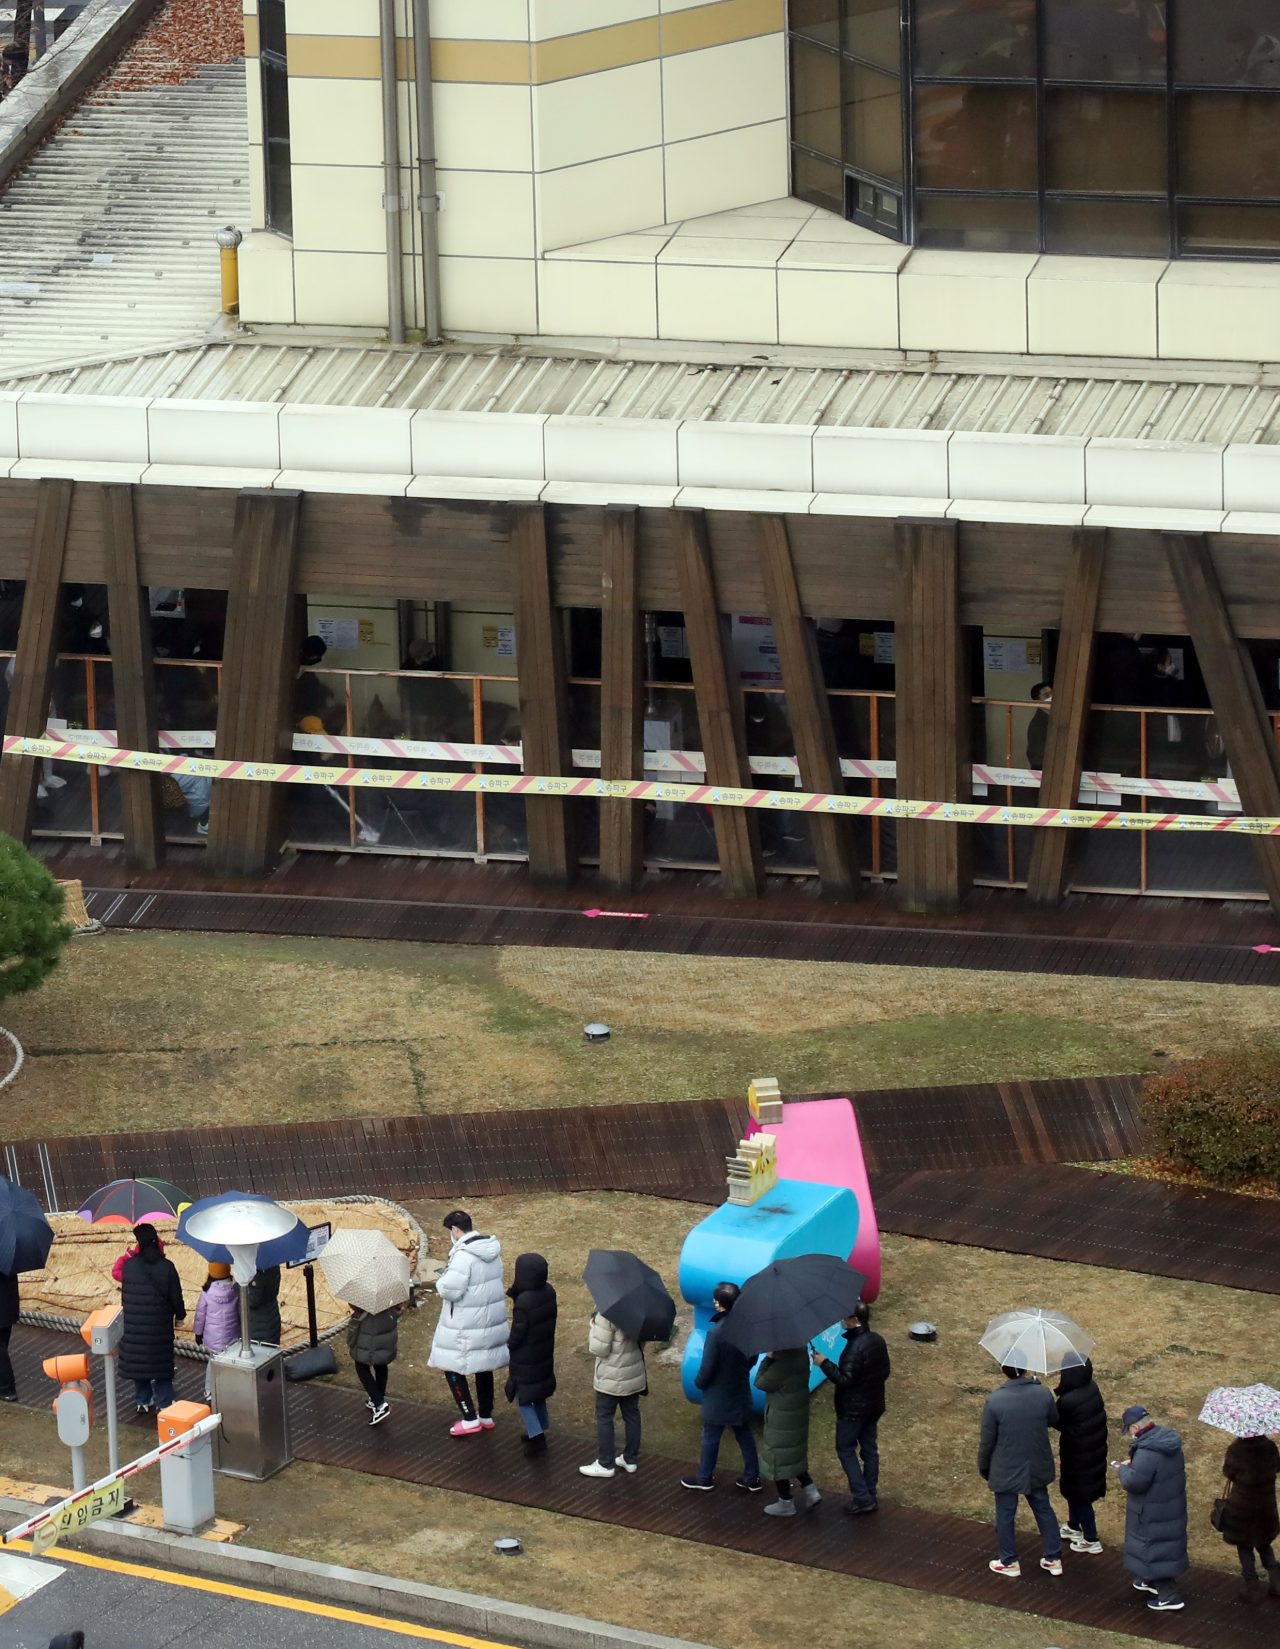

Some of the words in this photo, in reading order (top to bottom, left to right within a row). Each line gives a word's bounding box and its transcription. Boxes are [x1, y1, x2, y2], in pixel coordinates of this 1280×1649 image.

[32, 744, 52, 753] 송파구
[86, 751, 107, 760] 송파구
[142, 758, 163, 766] 송파구
[198, 764, 219, 773] 송파구
[255, 768, 276, 777] 송파구
[313, 772, 334, 780] 송파구
[371, 774, 393, 783] 송파구
[430, 777, 451, 785] 송파구
[488, 779, 510, 788] 송파구
[547, 782, 568, 791] 송파구
[606, 784, 627, 793] 송파구
[664, 788, 686, 797] 송파구
[722, 792, 743, 801] 송파구
[779, 796, 801, 805] 송파구
[836, 800, 858, 809] 송파구
[895, 805, 916, 814] 송파구
[953, 809, 975, 817] 송파구
[1011, 812, 1033, 821] 송파구
[1070, 815, 1093, 824] 송파구
